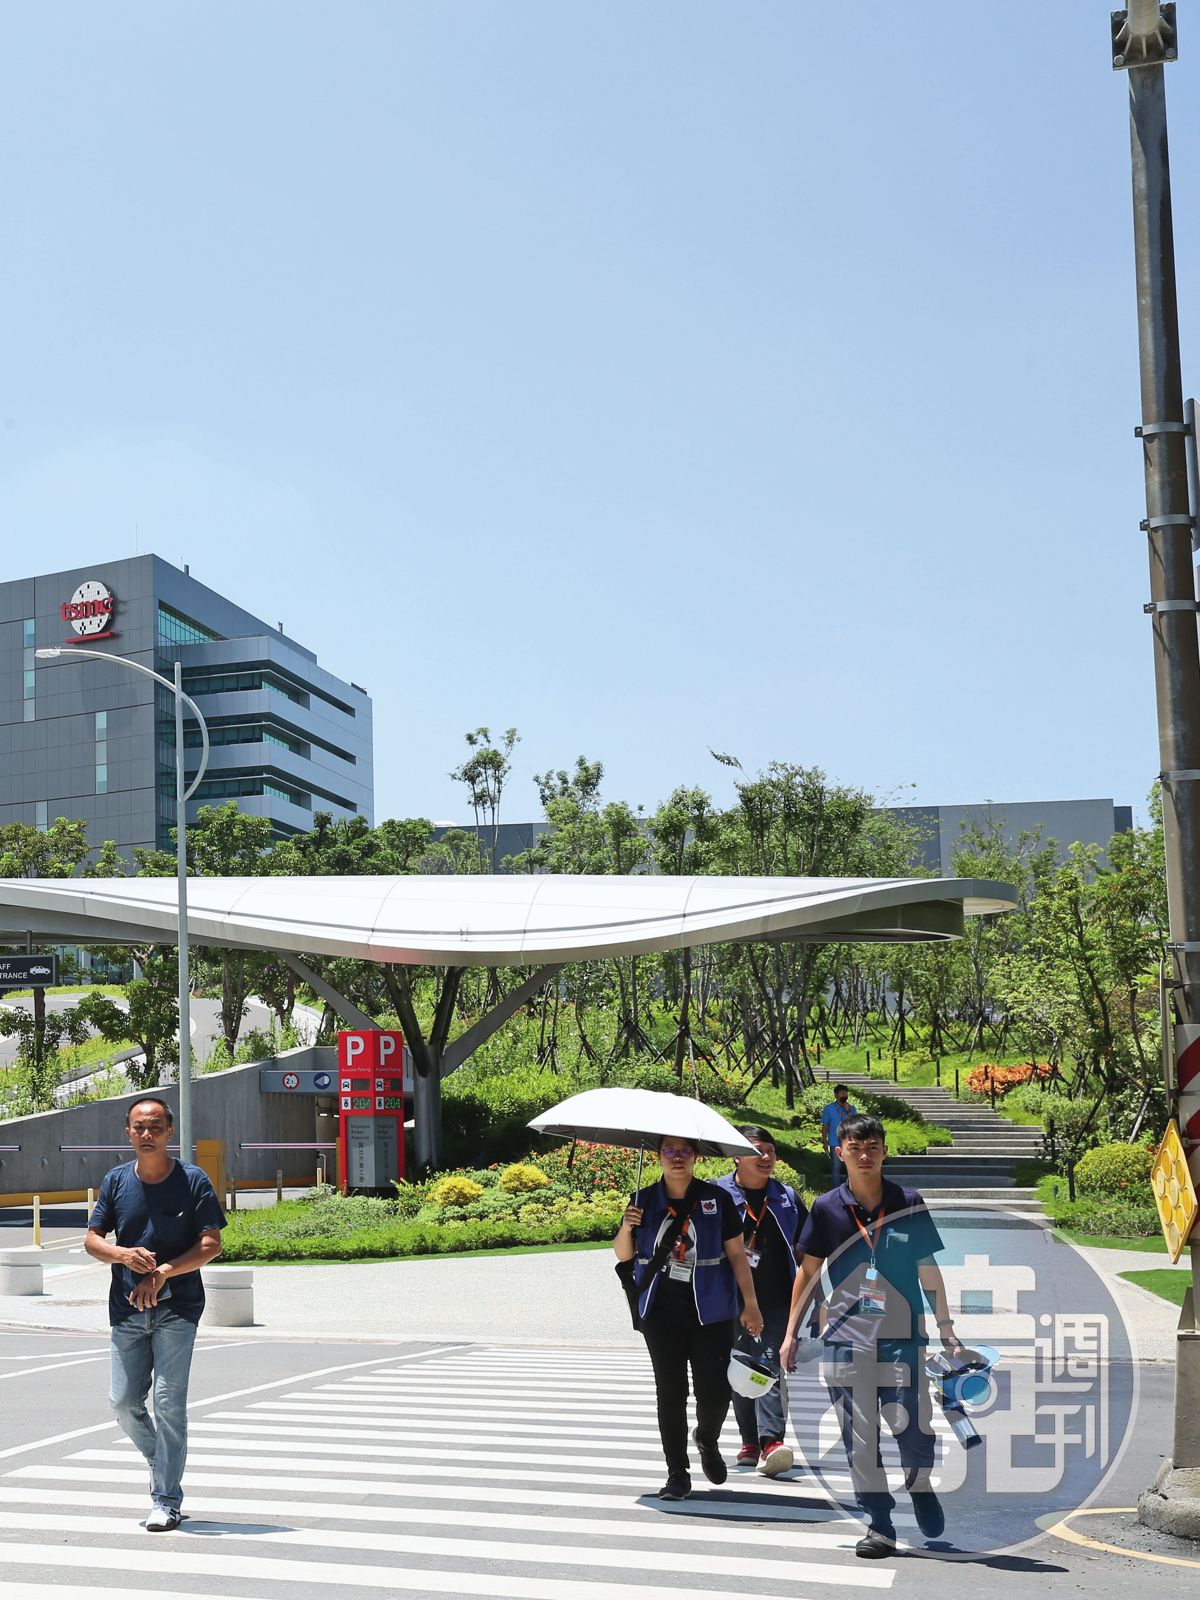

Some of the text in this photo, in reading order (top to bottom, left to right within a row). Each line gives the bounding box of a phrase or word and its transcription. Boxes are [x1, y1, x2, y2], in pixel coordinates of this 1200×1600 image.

[60, 597, 113, 621] tsmc
[346, 1035, 365, 1066] P
[380, 1035, 396, 1066] P
